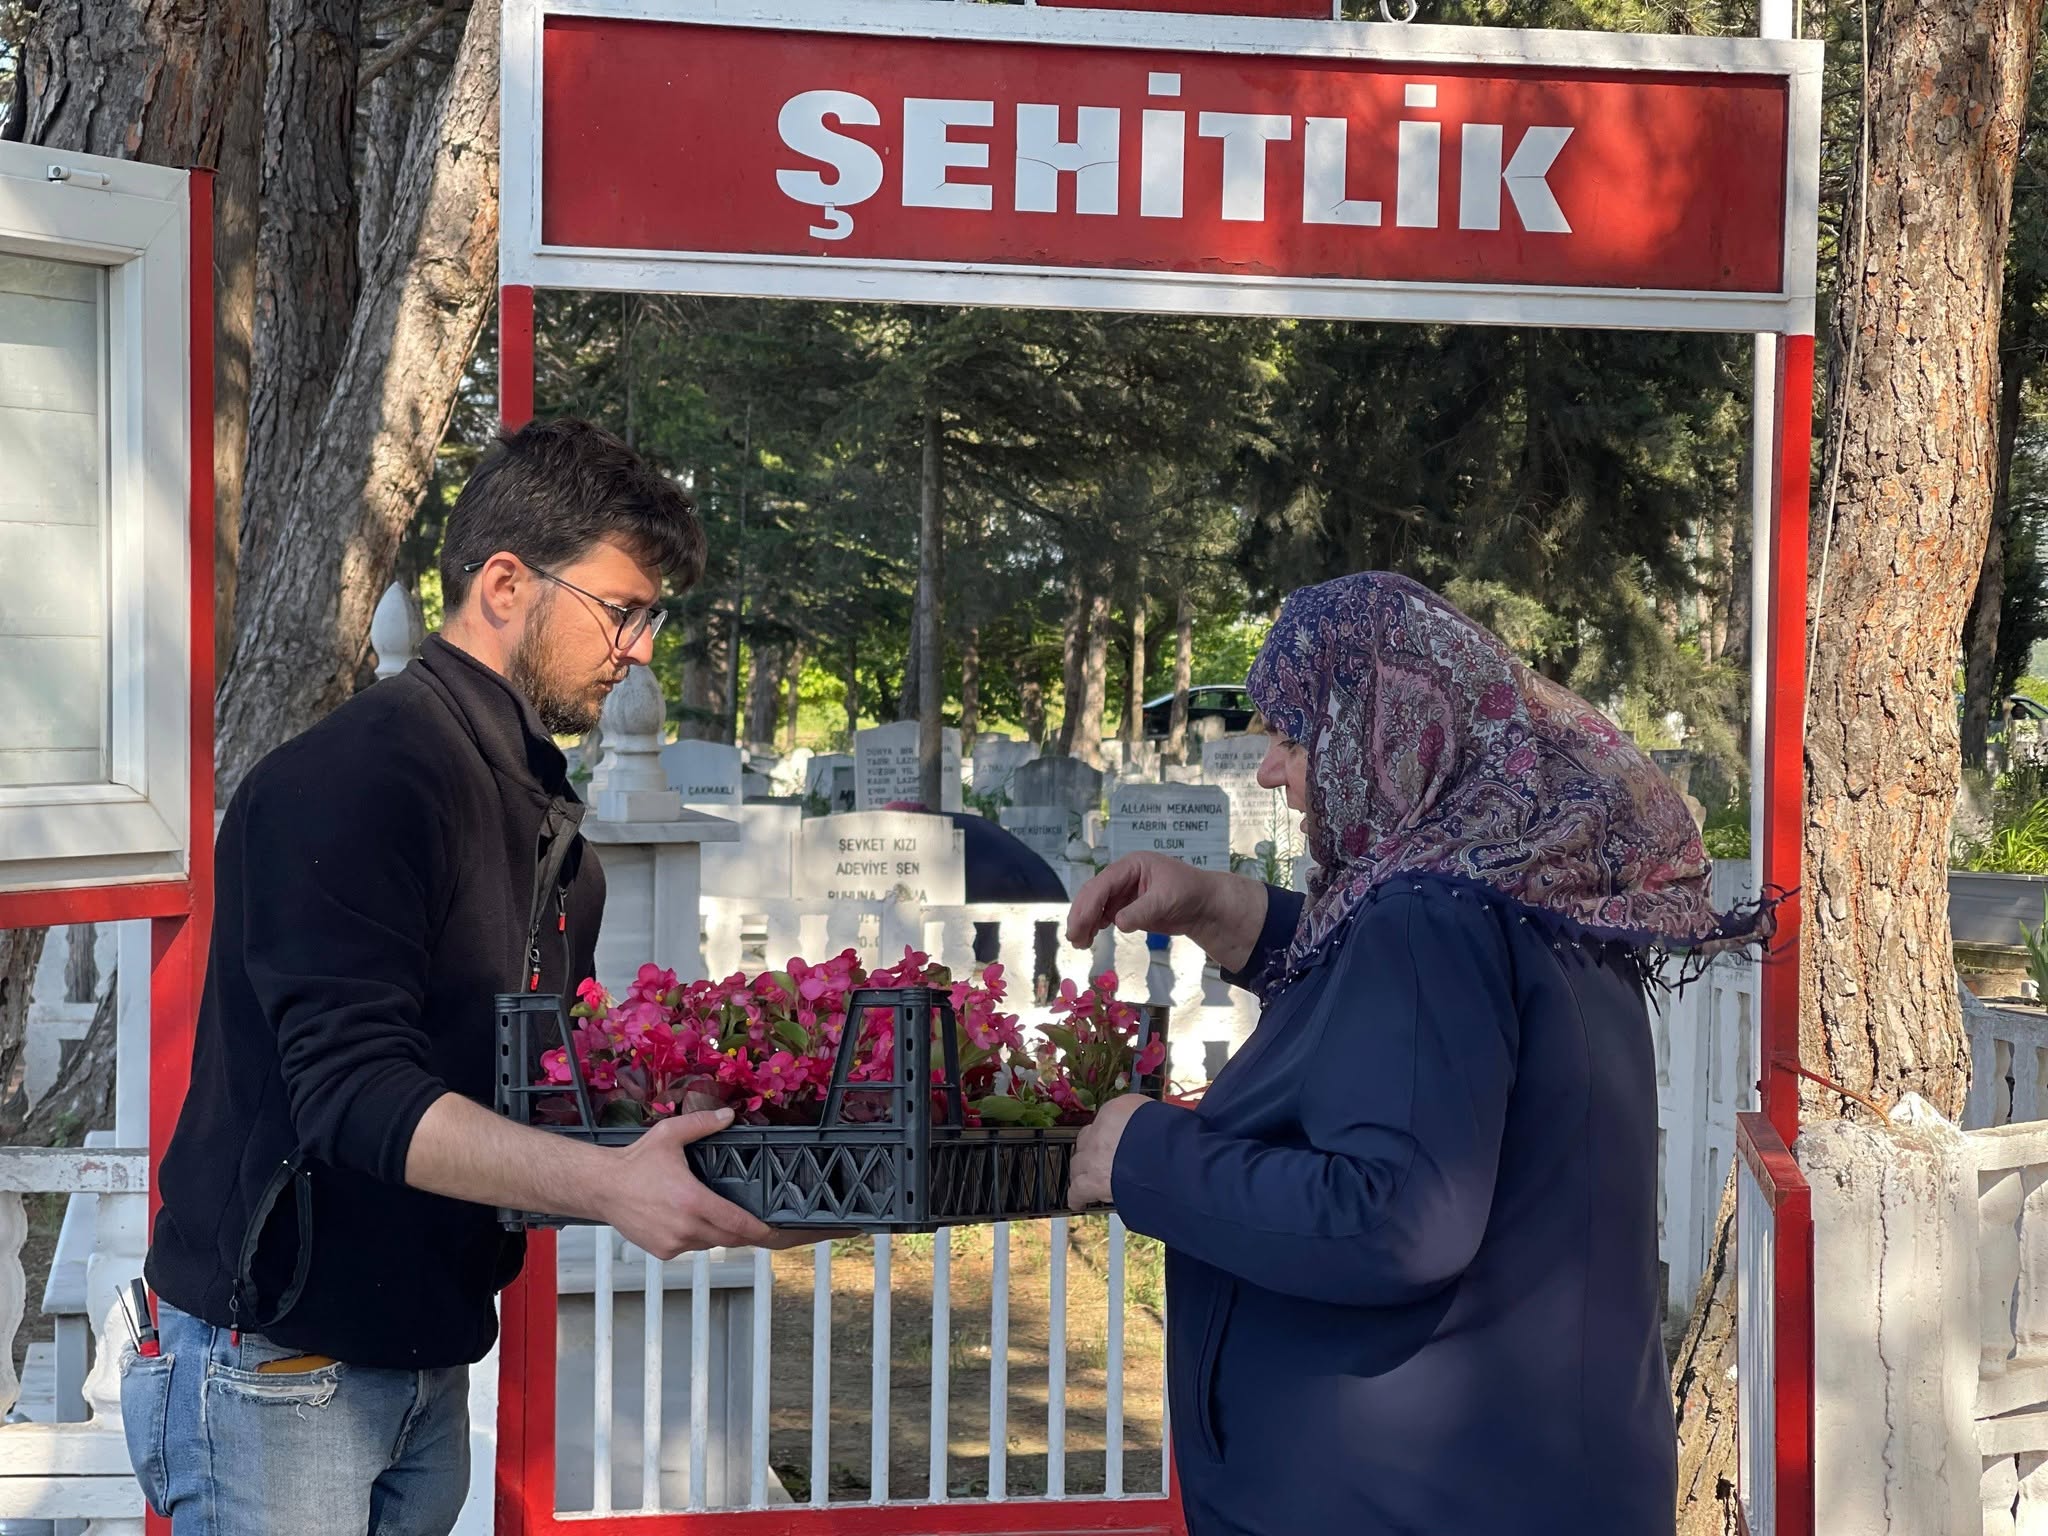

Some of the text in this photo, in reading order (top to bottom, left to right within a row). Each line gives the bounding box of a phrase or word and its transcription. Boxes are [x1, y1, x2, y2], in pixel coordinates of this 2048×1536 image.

[775, 72, 1575, 241] ŞEHİTLİK
[1167, 803, 1223, 815] MEKANINDA
[1172, 820, 1209, 832] CENNET
[838, 838, 917, 854] ŞEVKET KIZI
[1153, 838, 1185, 849] OLSUN
[1191, 855, 1208, 866] YAT
[835, 859, 889, 876] ADEVİYE
